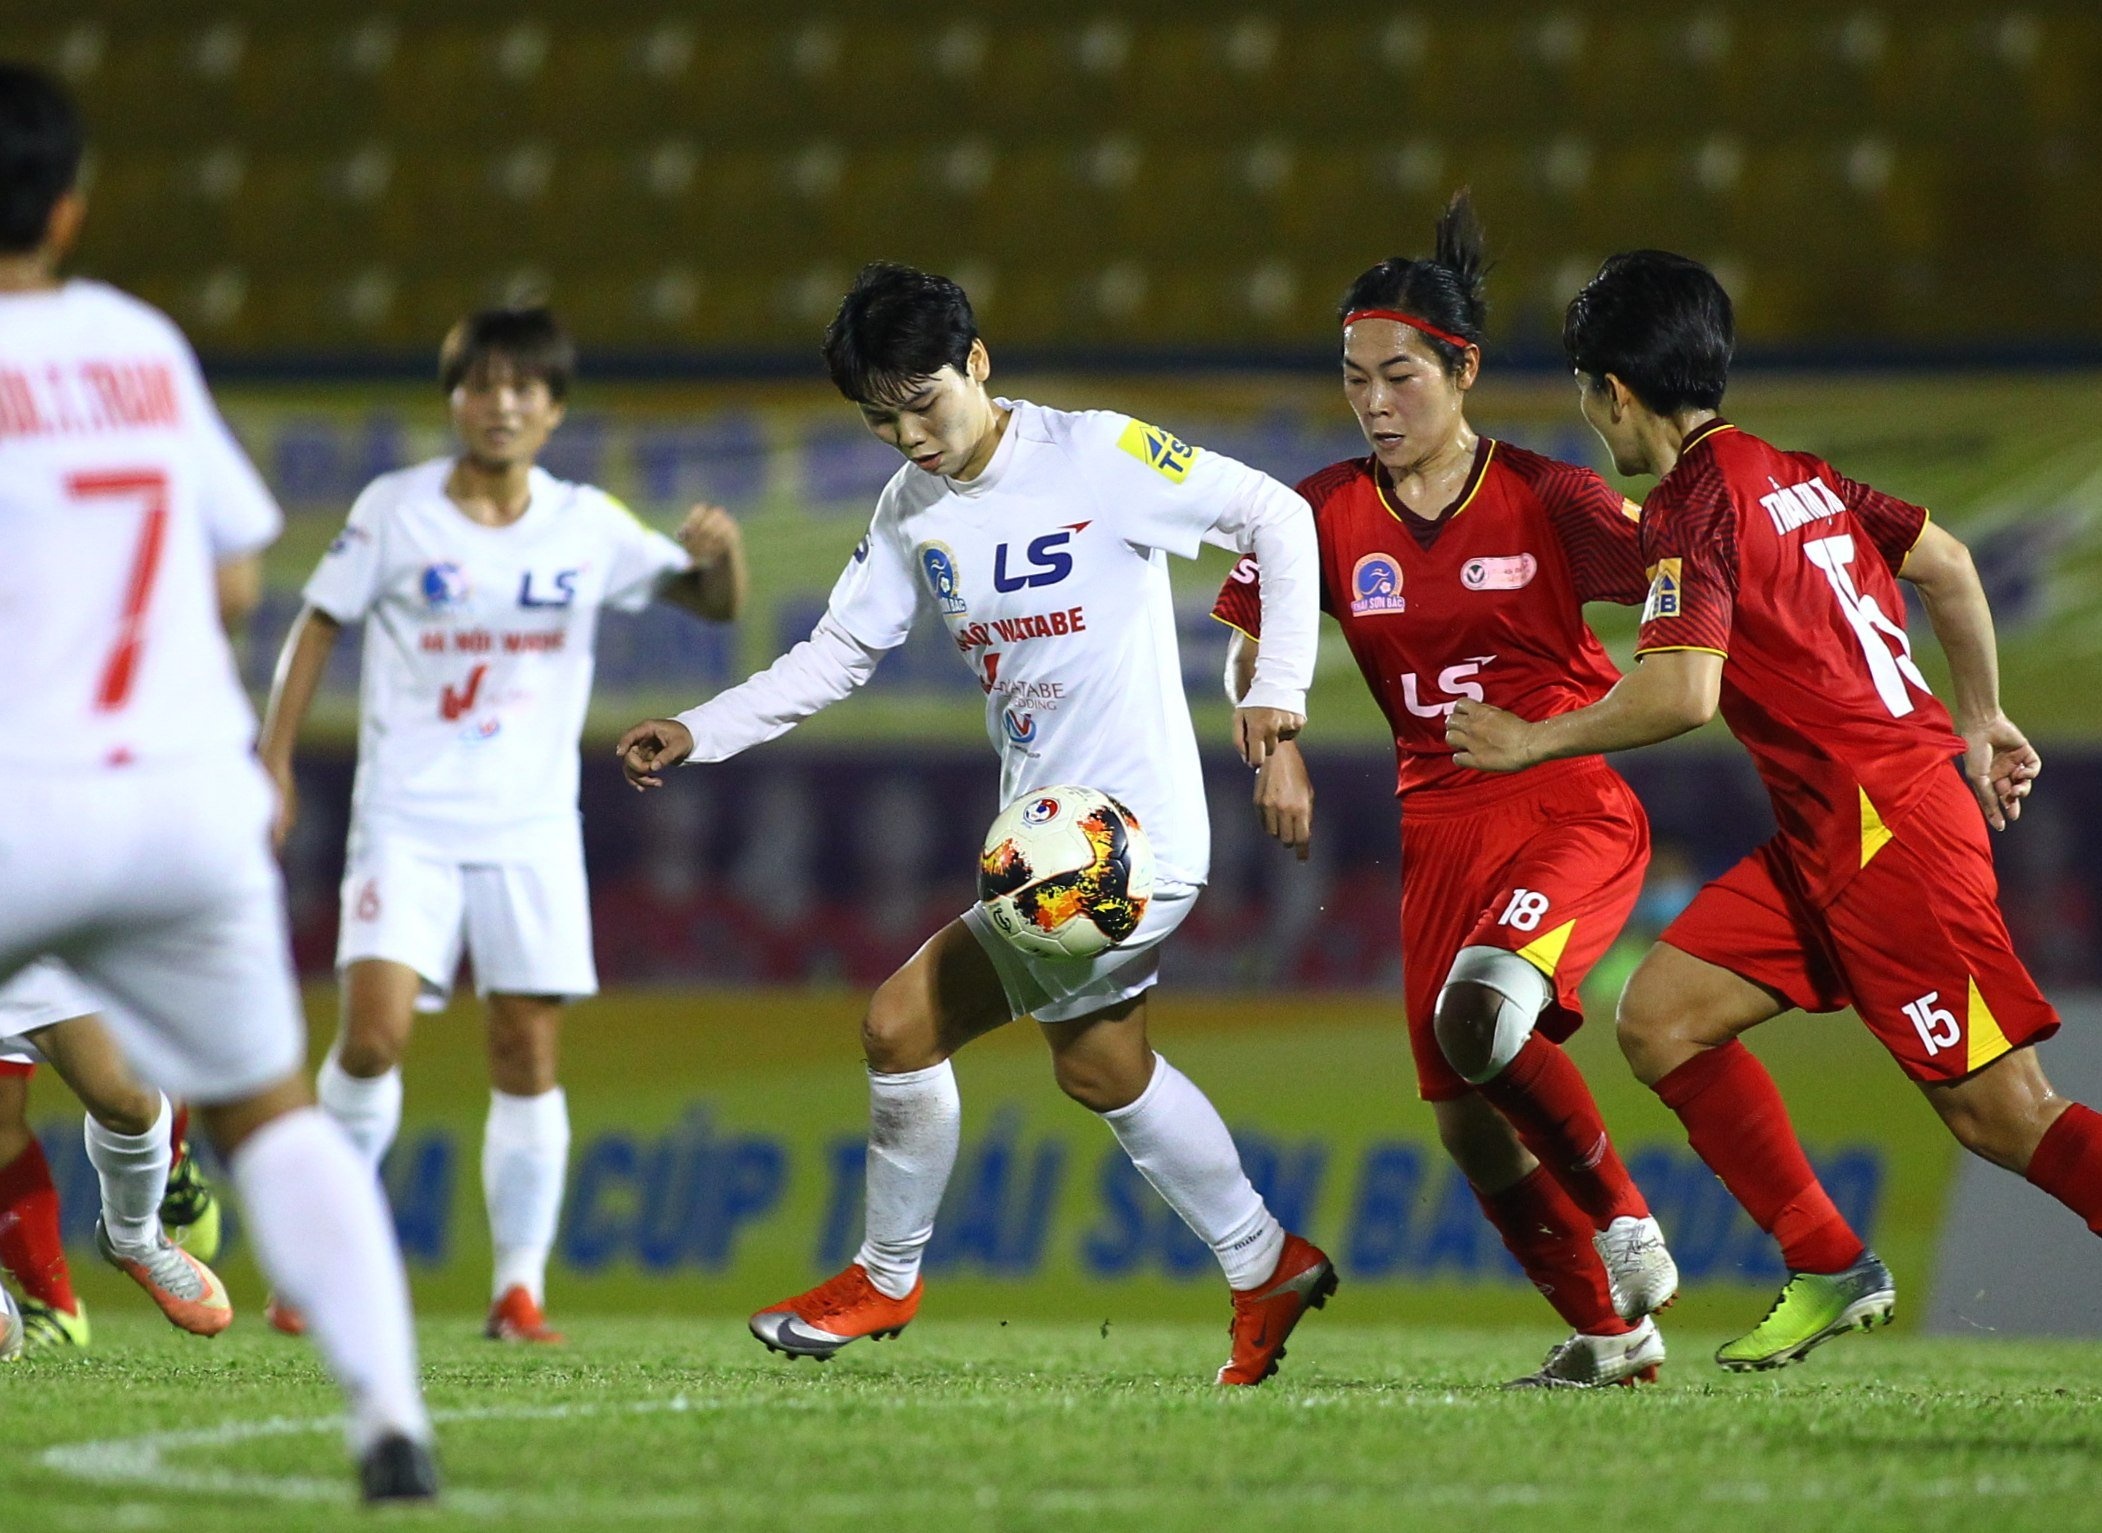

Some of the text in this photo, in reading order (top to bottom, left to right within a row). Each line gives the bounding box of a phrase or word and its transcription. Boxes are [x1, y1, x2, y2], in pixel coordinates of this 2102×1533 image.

[994, 531, 1073, 593] LS
[68, 470, 168, 715] 7
[518, 571, 578, 609] LS
[992, 606, 1086, 642] WATABE
[1401, 663, 1484, 718] LS
[1498, 888, 1549, 931] 18
[1901, 991, 1960, 1056] 15
